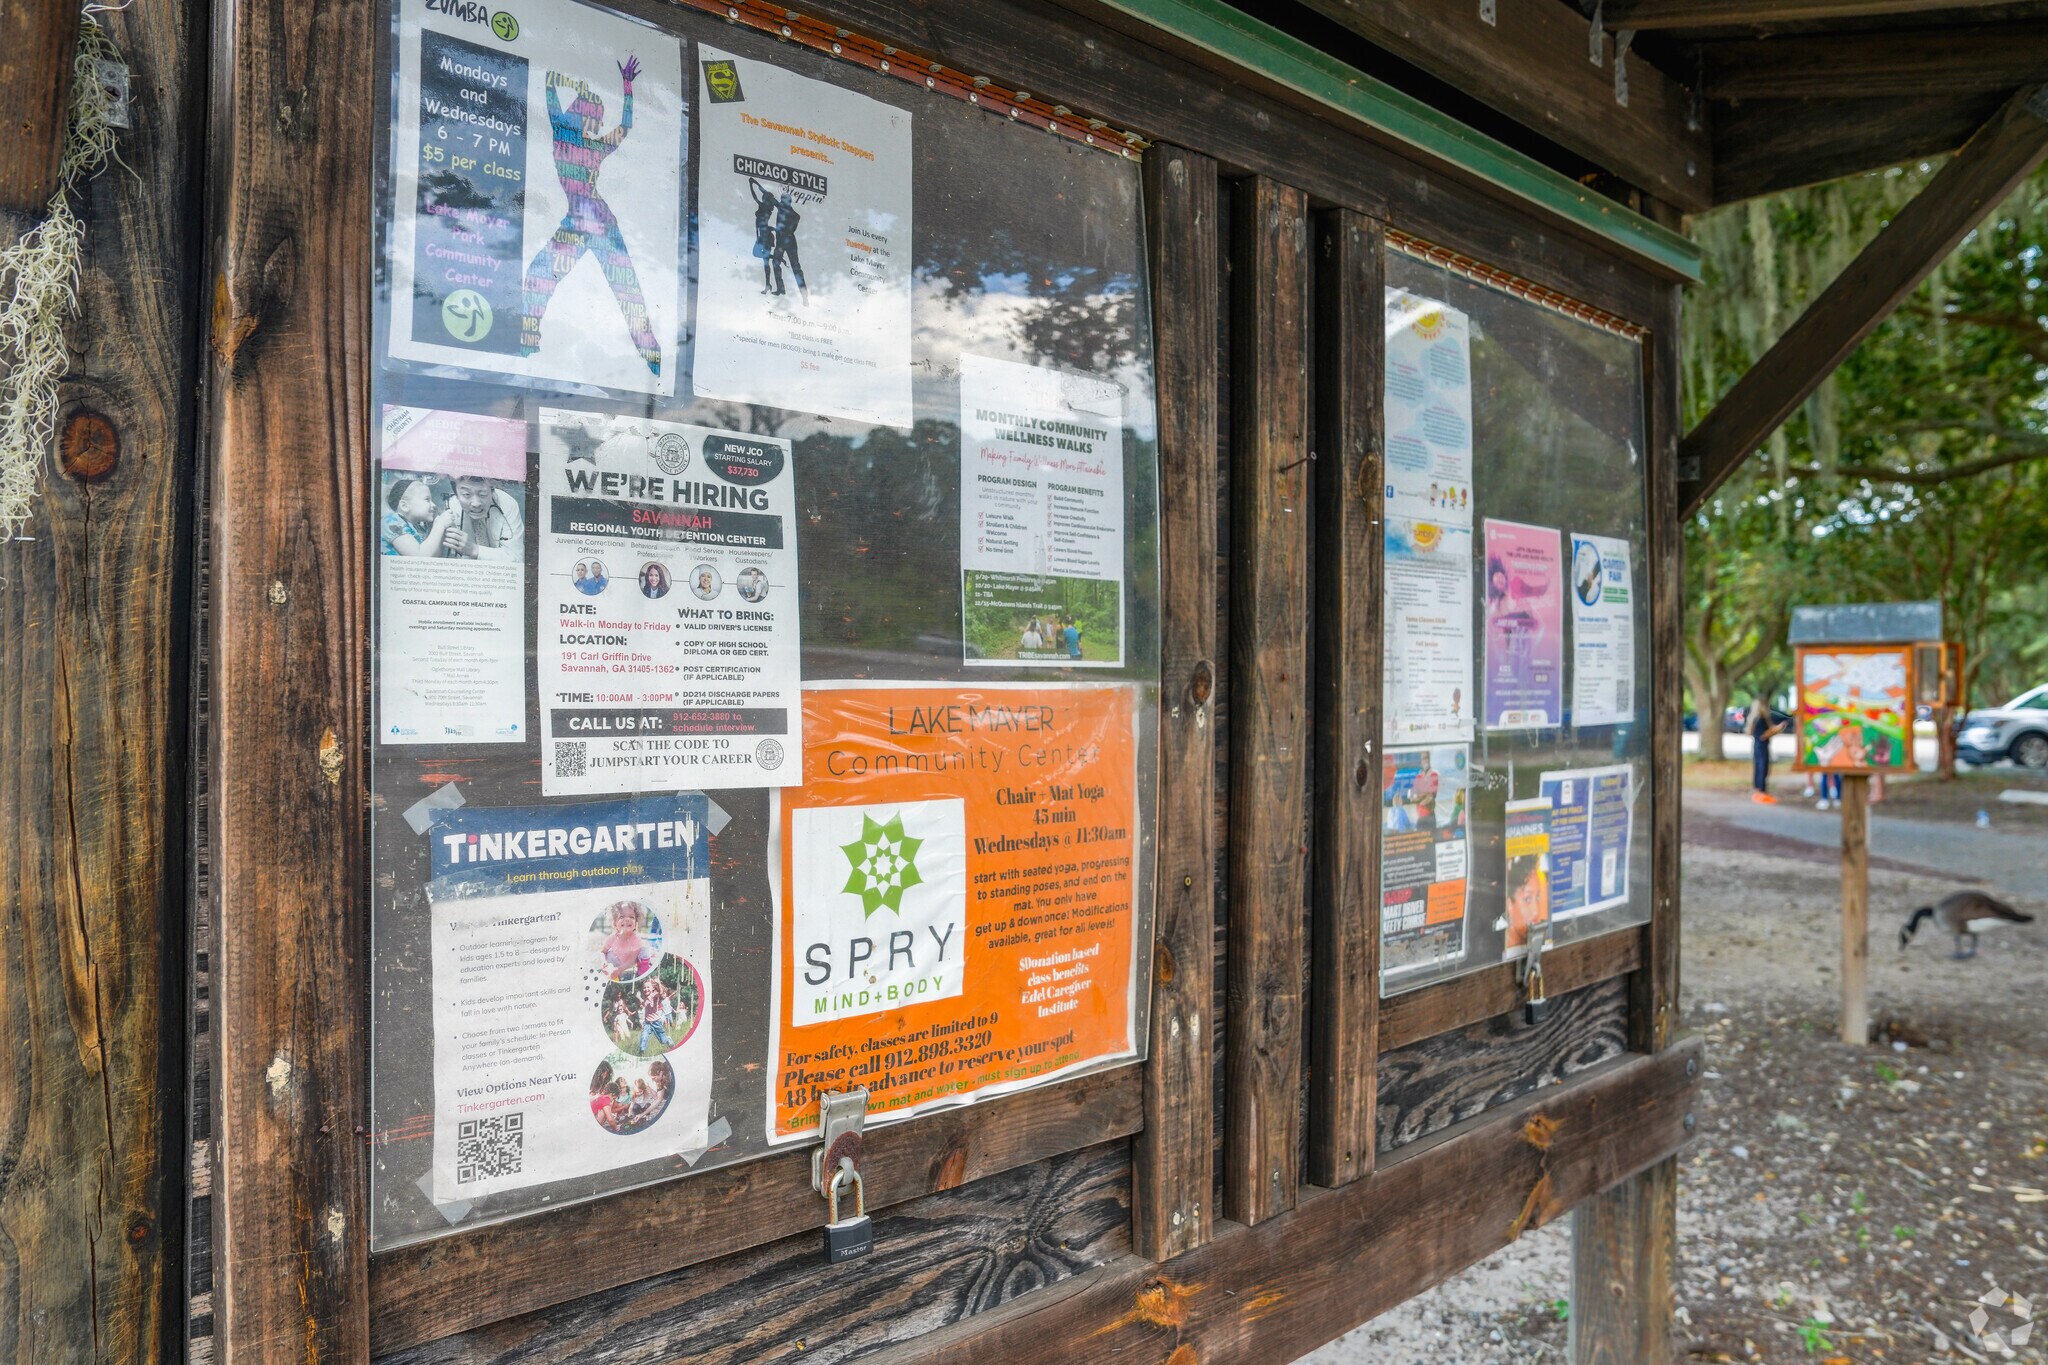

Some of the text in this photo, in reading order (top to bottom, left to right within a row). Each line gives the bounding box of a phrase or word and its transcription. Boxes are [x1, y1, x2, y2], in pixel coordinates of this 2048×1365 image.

[425, 0, 489, 27] ZUMBA
[439, 56, 508, 87] Mondays
[460, 86, 488, 104] and
[425, 98, 521, 135] Wednesdays
[437, 125, 448, 140] 6
[472, 134, 482, 149] 7
[489, 138, 511, 157] PM
[740, 112, 875, 161] The Savannah Stylistic Steppers
[422, 143, 521, 181] $5 per class
[790, 144, 834, 165] presents...
[736, 157, 825, 191] CHICAGO STYLE
[426, 201, 510, 230] Lake Mayer
[452, 227, 485, 246] Park
[848, 226, 888, 244] Join Us every
[425, 244, 502, 272] Community
[873, 246, 879, 254] at
[880, 248, 890, 257] the
[850, 254, 886, 270] Lake Mayer
[445, 268, 494, 288] Center
[850, 268, 886, 284] Community
[857, 284, 878, 295] Center
[809, 363, 820, 372] fee
[386, 410, 409, 432] CHATHAM
[393, 416, 413, 436] COUNTY
[976, 409, 1107, 442] MONTHLY COMMUNITY
[724, 443, 763, 457] NEW JCO
[995, 428, 1093, 454] WELLNESS WALKS
[714, 453, 773, 467] STARTING SALARY
[980, 447, 1007, 467] Making
[727, 465, 759, 477] $37,730
[565, 468, 769, 510] WE'RE HIRING
[978, 475, 1037, 488] PROGRAM DESIGN
[1048, 482, 1104, 497] PROGRAM BENEFITS
[632, 509, 712, 529] SAVANNAH
[570, 522, 628, 535] REGIONAL
[630, 525, 663, 538] YOUTH
[726, 534, 766, 546] CENTER
[560, 604, 597, 614] DATE:
[678, 608, 775, 621] WHAT TO BRING:
[560, 619, 671, 632] Walk-in Monday to Friday
[684, 623, 707, 632] VALID
[708, 624, 742, 632] DRIVER'S
[560, 635, 627, 646] LOCATION:
[561, 652, 652, 662] 191 Carl Griffin Drive
[561, 663, 674, 674] Savannah, GA 31405-1362
[596, 693, 633, 703] 10:00AM
[642, 694, 673, 703] 3:00PM
[569, 717, 663, 730] CALL US AT:
[673, 712, 742, 721] 912-652-3880 to
[889, 705, 1054, 736] LAKE MAYER
[673, 723, 757, 732] schedule interview.
[613, 739, 730, 752] SCAN THE CODE TO
[590, 753, 752, 769] JUMPSTART YOUR CAREER
[828, 743, 1099, 777] Community Center
[996, 787, 1036, 806] Chair
[1050, 787, 1074, 801] Mat
[1077, 784, 1105, 803] Yoga
[1033, 807, 1076, 825] 45 min
[443, 819, 695, 864] TiNKERGARTEN
[974, 827, 1126, 856] Wednesdays @ 11:30am
[507, 870, 537, 884] Learn
[539, 868, 579, 882] through
[581, 864, 620, 877] outdoor
[804, 923, 955, 986] SPRY
[1019, 943, 1100, 972] $Donation based
[1027, 964, 1089, 986] class benefits
[814, 976, 943, 1014] MIND+BODY
[1021, 978, 1092, 1004] Edel Caregiver
[1037, 998, 1079, 1018] Institute
[787, 1011, 999, 1067] For safety, classes are limited to 9
[784, 1029, 993, 1089] Please call 912.898.3320
[457, 1072, 577, 1099] View Options Near You:
[457, 1092, 545, 1114] Tinkergarten.com
[840, 1246, 867, 1256] Master
